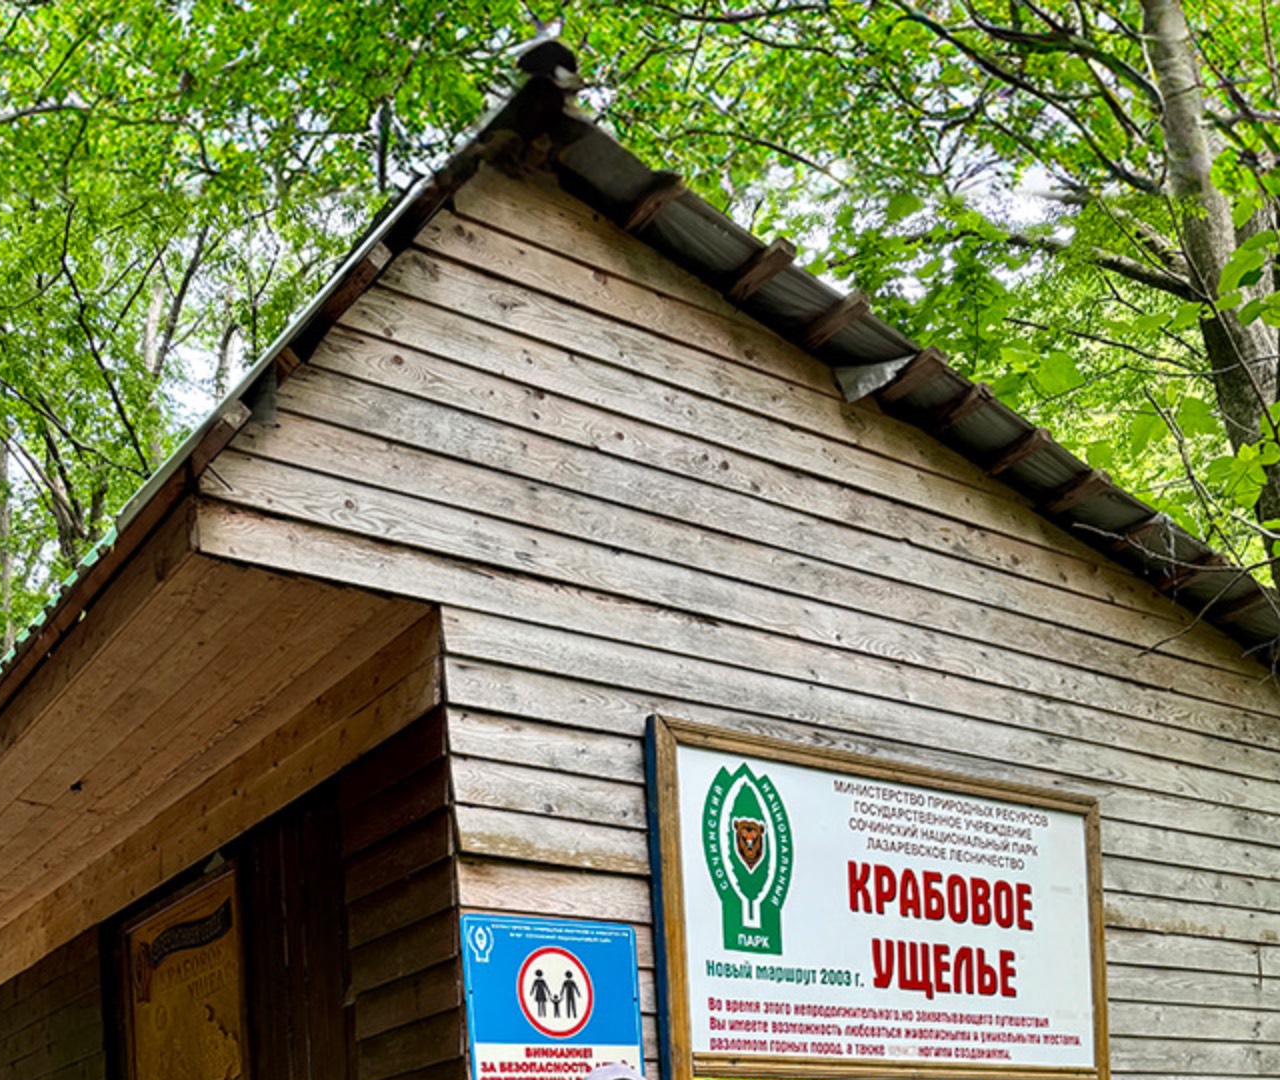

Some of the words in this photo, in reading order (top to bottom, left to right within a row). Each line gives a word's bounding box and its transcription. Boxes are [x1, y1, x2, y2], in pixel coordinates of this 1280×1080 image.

[833, 780, 924, 807] МИНИСТЕРСТВО
[928, 795, 994, 817] ПРИРОДНЫХ
[994, 806, 1049, 827] РЕСУРСОВ
[853, 801, 962, 829] ГОСУДАРСТВЕННОЕ
[964, 819, 1032, 840] УЧРЕЖДЕНИЕ
[849, 817, 919, 839] СОЧИНСКИЙ
[921, 829, 1010, 854] НАЦИОНАЛЬНЫЙ
[1011, 844, 1039, 857] ПАРК
[866, 837, 947, 861] ЛАЗАРЕВСКОЕ
[949, 850, 1025, 870] ЛЕСНИЧЕСТВО
[848, 859, 1034, 931] КРАБОВОЕ
[737, 933, 770, 948] ПАРК
[706, 959, 752, 979] Новый
[756, 965, 817, 986] маршрут
[820, 968, 852, 987] 2003
[854, 972, 865, 987] г.
[871, 938, 1017, 1000] УЩЕЛЬЕ
[707, 997, 722, 1011] Во
[726, 999, 760, 1014] время
[763, 1001, 791, 1016] этого
[916, 1010, 993, 1026] захватывающего
[995, 1014, 1050, 1028] путешествия
[709, 1017, 726, 1031] Вы
[728, 1019, 768, 1032] имеете
[771, 1020, 842, 1036] возможность
[844, 1024, 902, 1039] любоваться
[904, 1027, 971, 1042] живописными
[981, 1031, 1041, 1045] уникальными
[709, 1037, 767, 1051] разломом
[769, 1039, 808, 1053] горных
[855, 1043, 885, 1056] также
[480, 1062, 497, 1073] ЗА
[499, 1062, 592, 1073] БЕЗОПАСНОСТЬ
